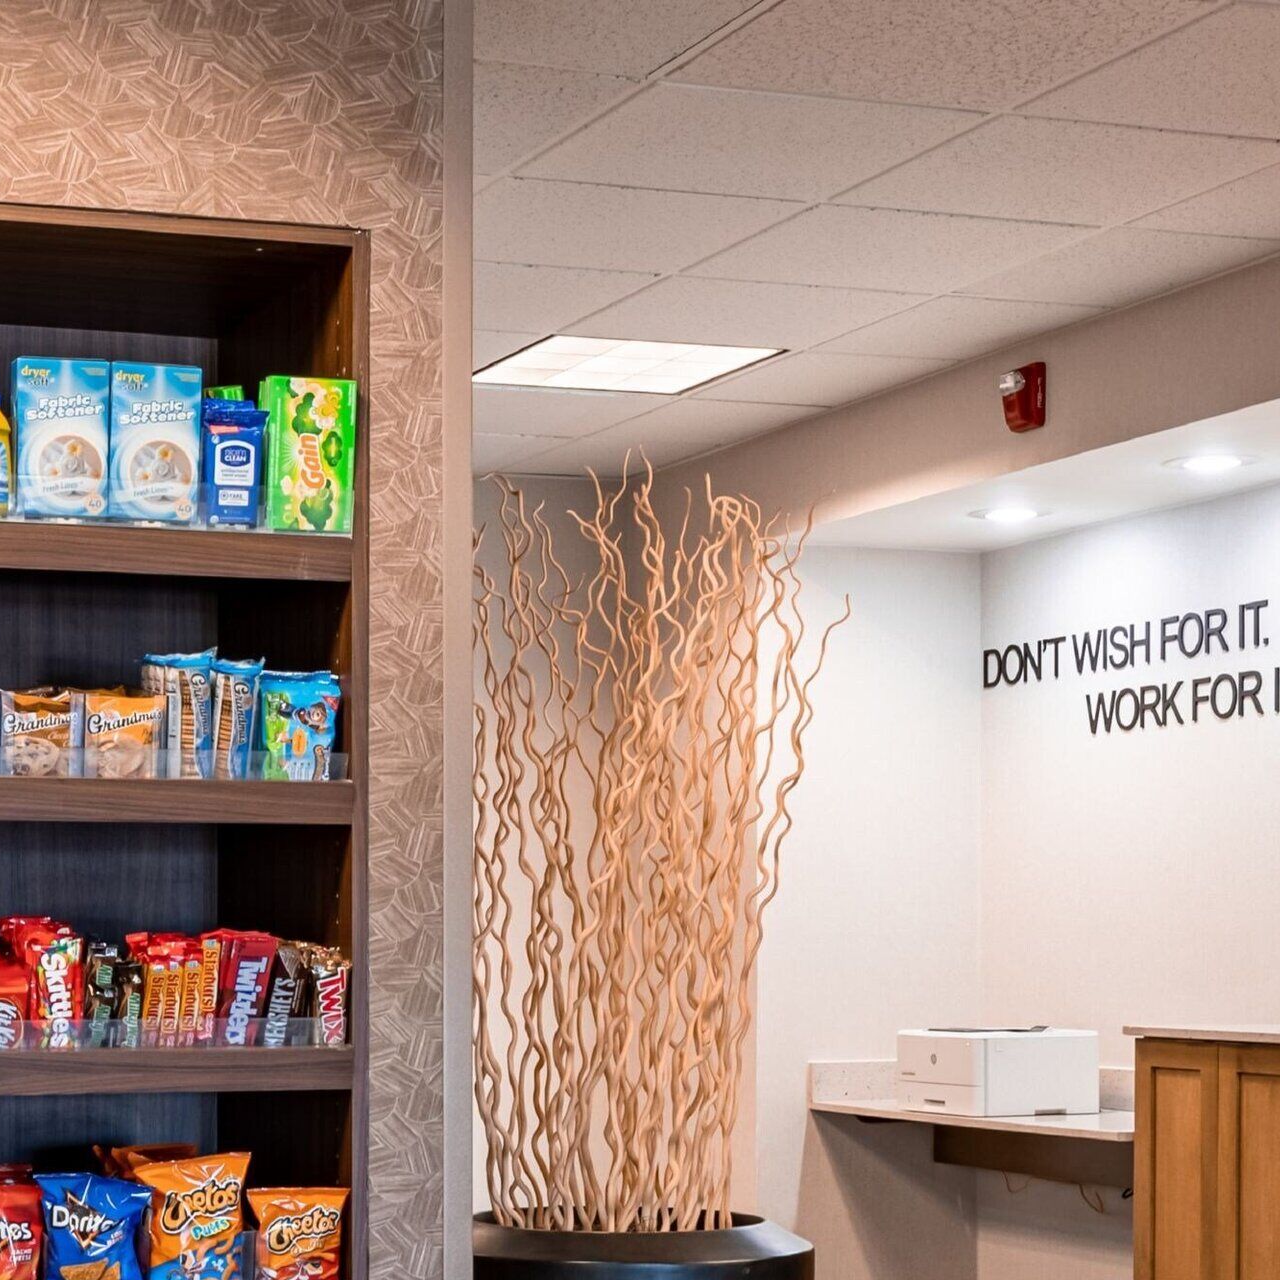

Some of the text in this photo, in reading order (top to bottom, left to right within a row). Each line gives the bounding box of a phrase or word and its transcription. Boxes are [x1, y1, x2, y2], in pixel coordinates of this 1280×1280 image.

[21, 364, 51, 378] dryer
[115, 370, 145, 384] dryer
[26, 403, 103, 421] Softener
[38, 394, 91, 409] Fabric
[120, 409, 194, 426] Softener
[131, 400, 184, 414] Fabric
[300, 436, 326, 489] Gain
[982, 599, 1270, 689] DON'T WISH FOR IT.
[1086, 680, 1184, 735] WORK
[1191, 670, 1265, 723] FOR
[40, 950, 73, 1048] Skittles
[317, 965, 347, 1045] TWIX
[268, 1206, 340, 1254] Cheetos
